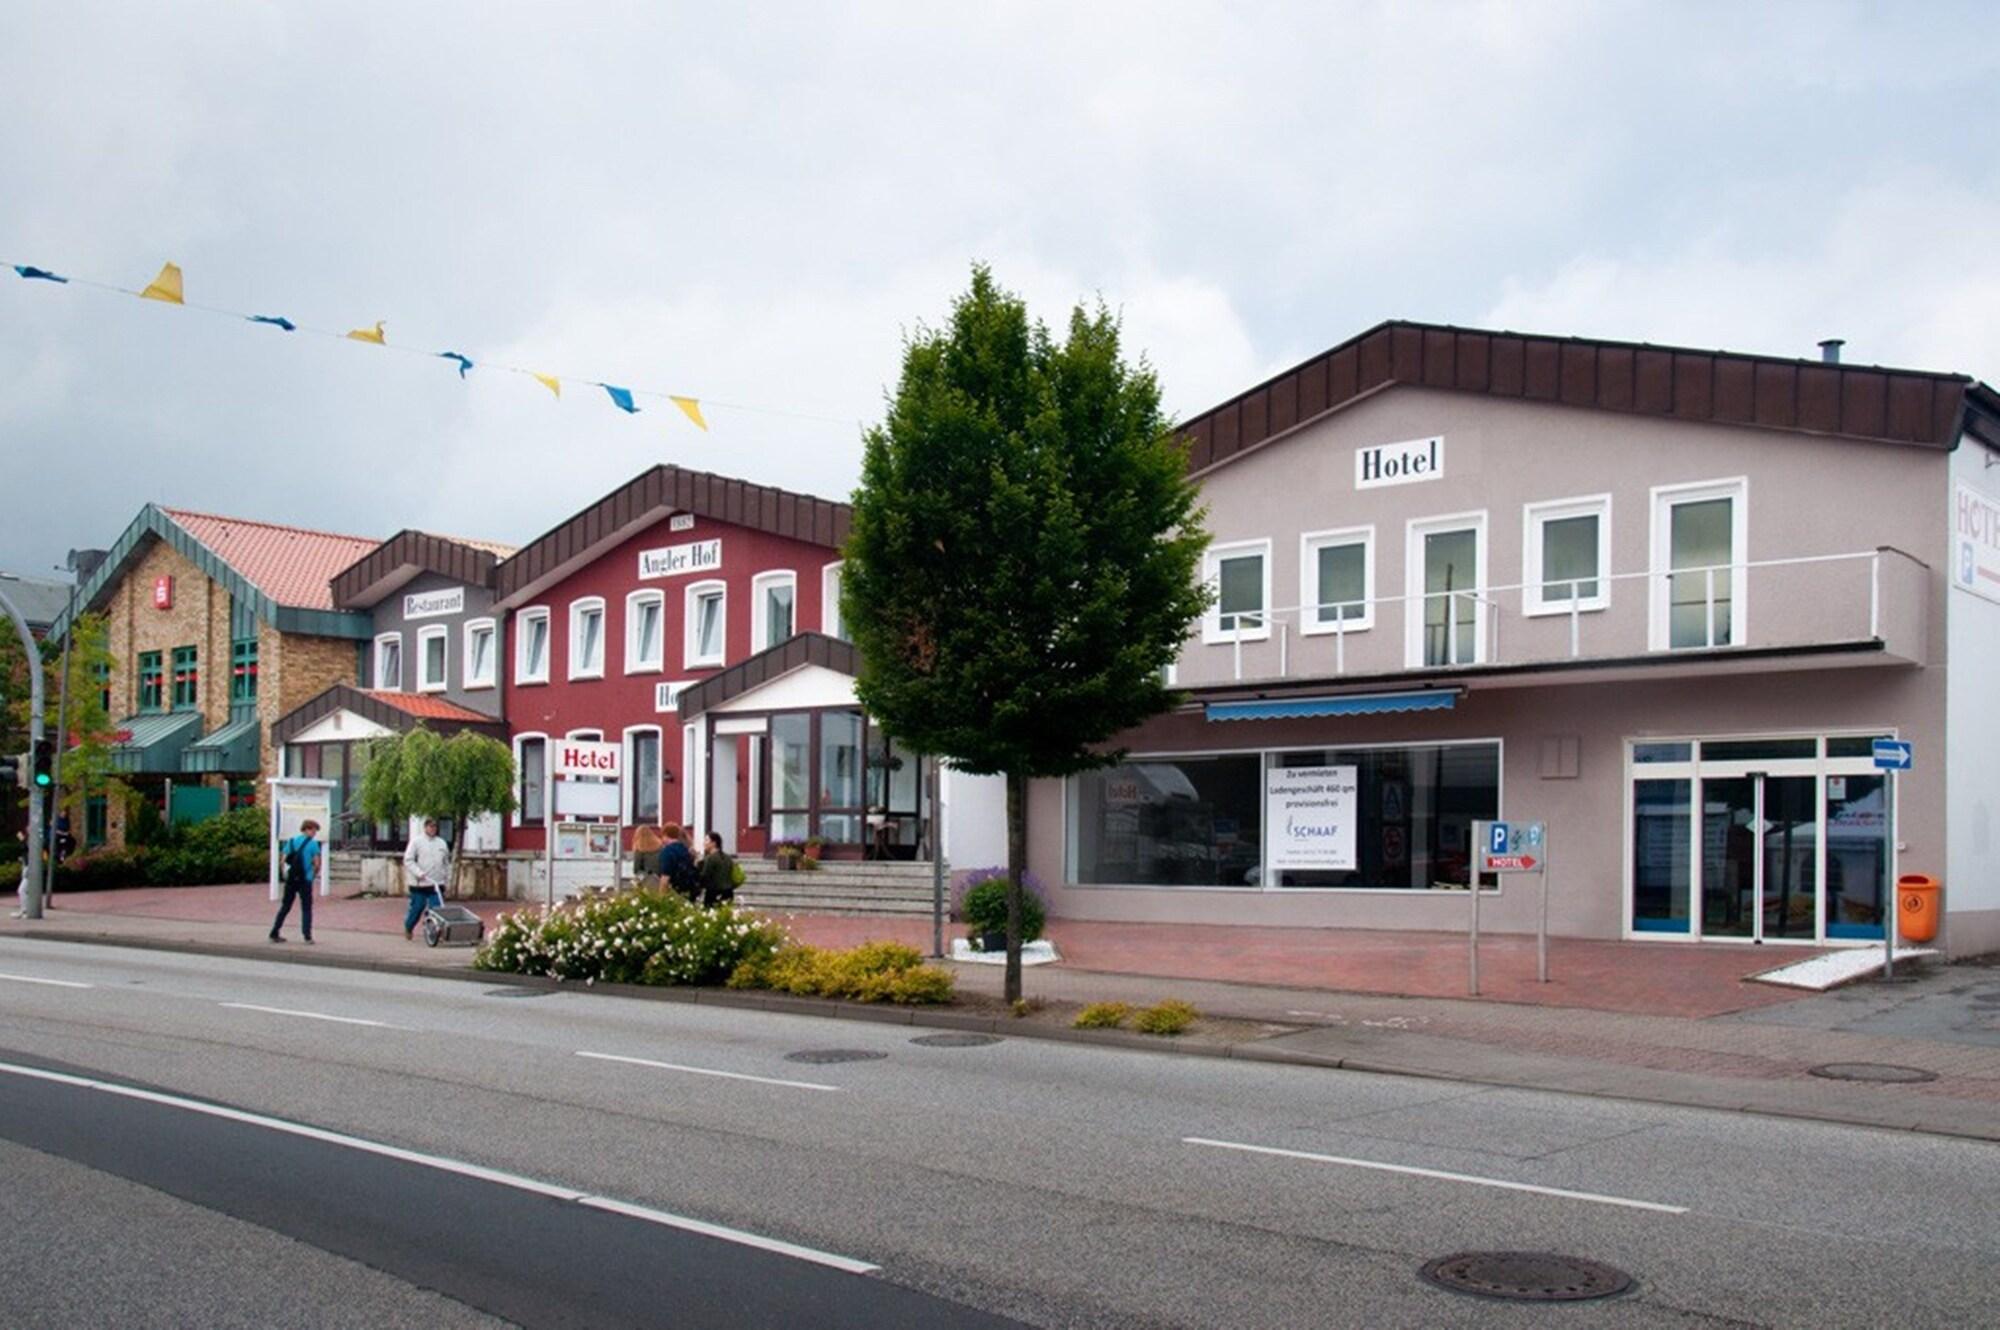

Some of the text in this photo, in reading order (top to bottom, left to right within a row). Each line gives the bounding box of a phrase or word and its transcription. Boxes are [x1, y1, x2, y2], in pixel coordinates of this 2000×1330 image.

[1362, 440, 1436, 480] Hotel
[642, 541, 718, 576] Angler Hof
[407, 594, 461, 615] Restaurant
[564, 748, 614, 769] Hotel
[1286, 769, 1338, 778] Zu vermieten
[1269, 785, 1324, 795] Ladengeschäft
[1286, 799, 1338, 808] provisionsfrei
[1293, 825, 1338, 837] SCHAAF
[1492, 857, 1521, 867] HOTEL
